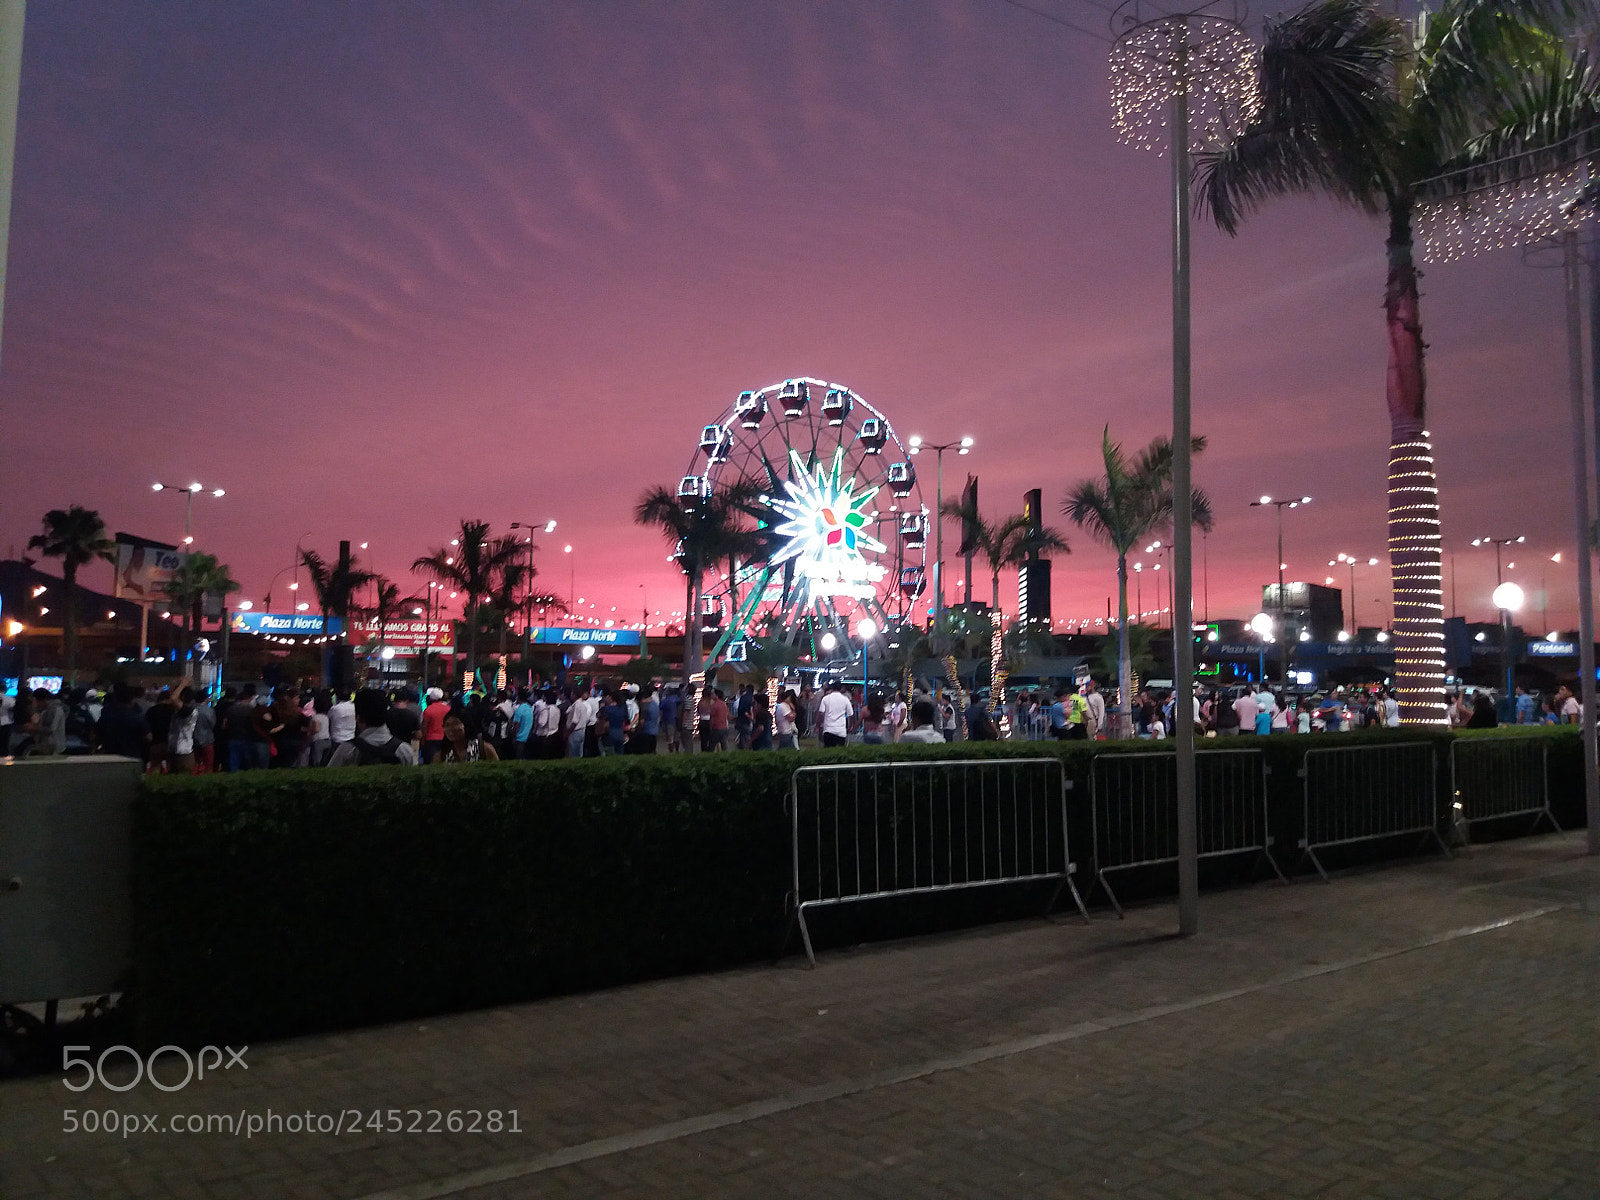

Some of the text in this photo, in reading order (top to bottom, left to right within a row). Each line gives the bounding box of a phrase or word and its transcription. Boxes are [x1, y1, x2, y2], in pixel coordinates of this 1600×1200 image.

[260, 615, 323, 630] Plaza Norte
[440, 623, 451, 633] AL
[562, 628, 617, 642] Plaza Norte
[1245, 644, 1269, 654] Nore
